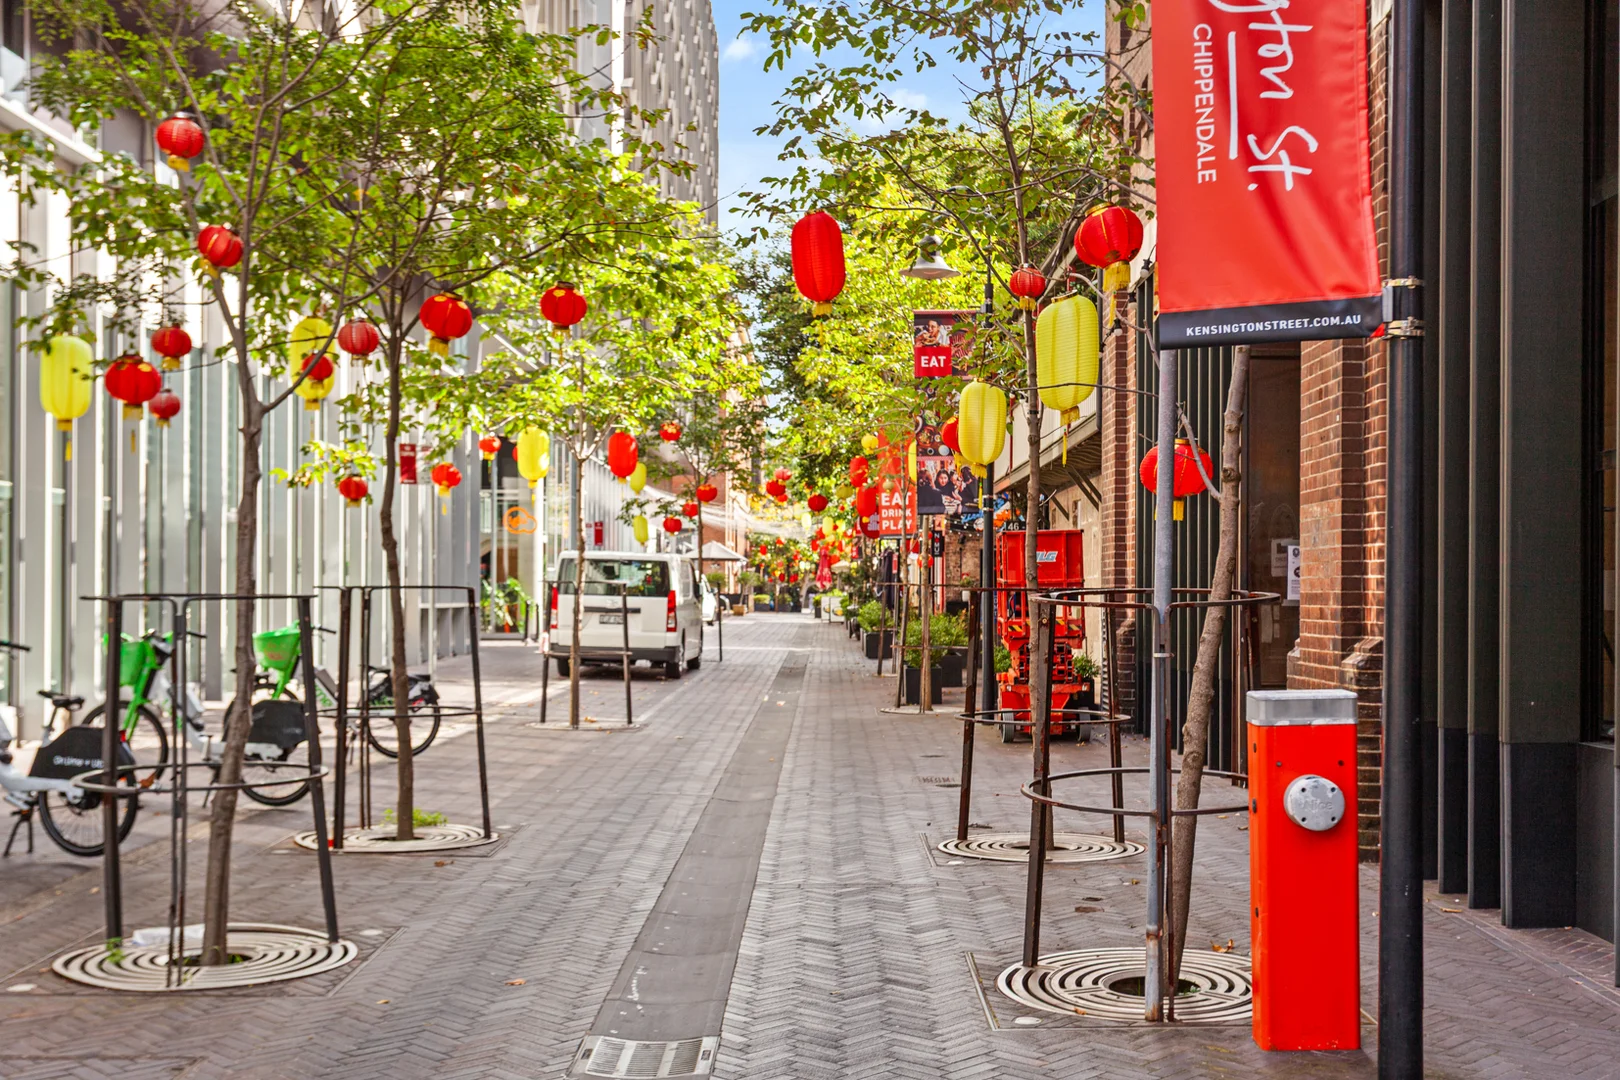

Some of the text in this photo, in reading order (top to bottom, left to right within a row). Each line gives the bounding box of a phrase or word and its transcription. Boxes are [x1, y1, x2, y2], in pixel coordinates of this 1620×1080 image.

[1193, 23, 1217, 184] CHIPPENDALE
[1247, 125, 1318, 191] St.
[1186, 314, 1362, 336] KENSINGTONSTREET.COM.AU
[920, 355, 946, 368] EAT
[881, 492, 912, 506] EAT
[882, 520, 912, 530] PLAY
[1007, 522, 1020, 531] 46
